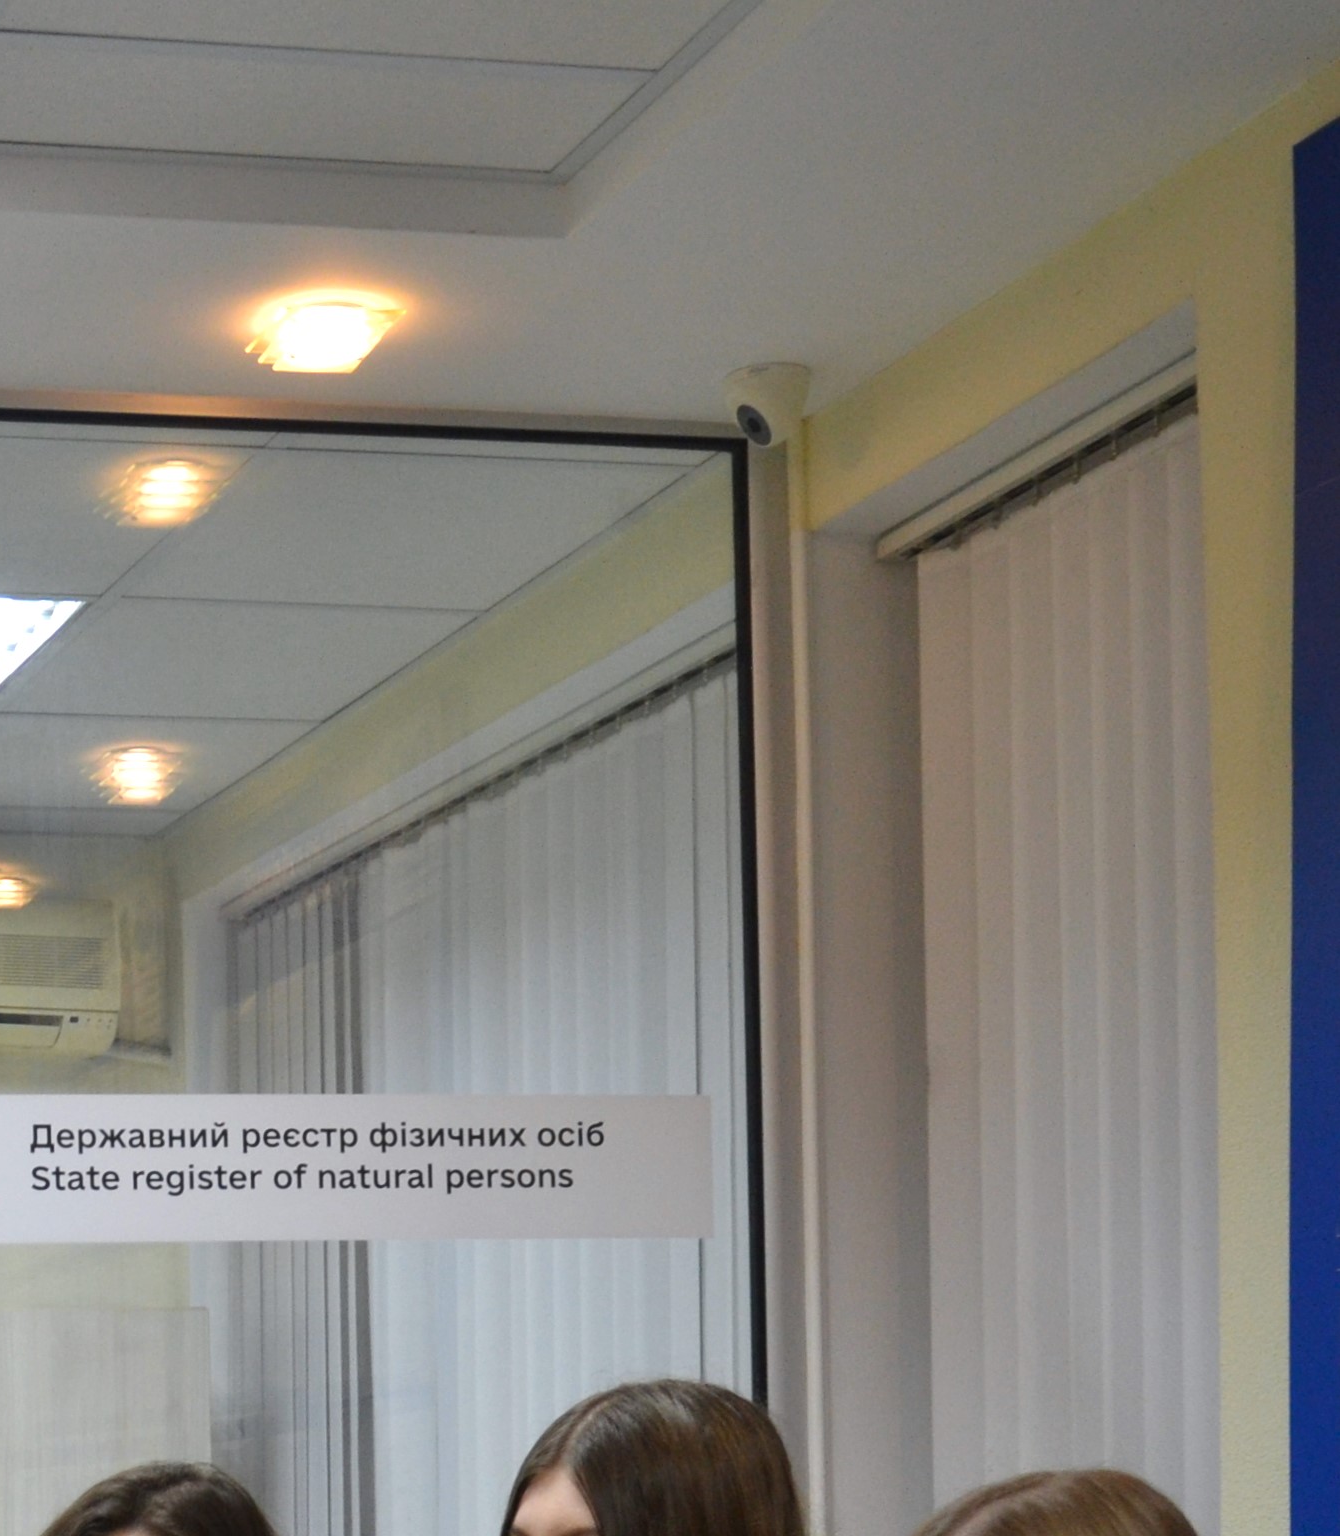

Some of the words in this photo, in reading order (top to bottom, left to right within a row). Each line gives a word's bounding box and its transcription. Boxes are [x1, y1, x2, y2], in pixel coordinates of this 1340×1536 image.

[30, 1122, 229, 1155] Державний
[241, 1127, 359, 1155] реєстр
[369, 1121, 526, 1154] фізичних
[537, 1121, 605, 1148] осіб
[31, 1165, 121, 1192] State
[132, 1164, 263, 1197] register
[273, 1162, 309, 1190] of
[319, 1162, 434, 1190] natural
[445, 1166, 574, 1195] persons
